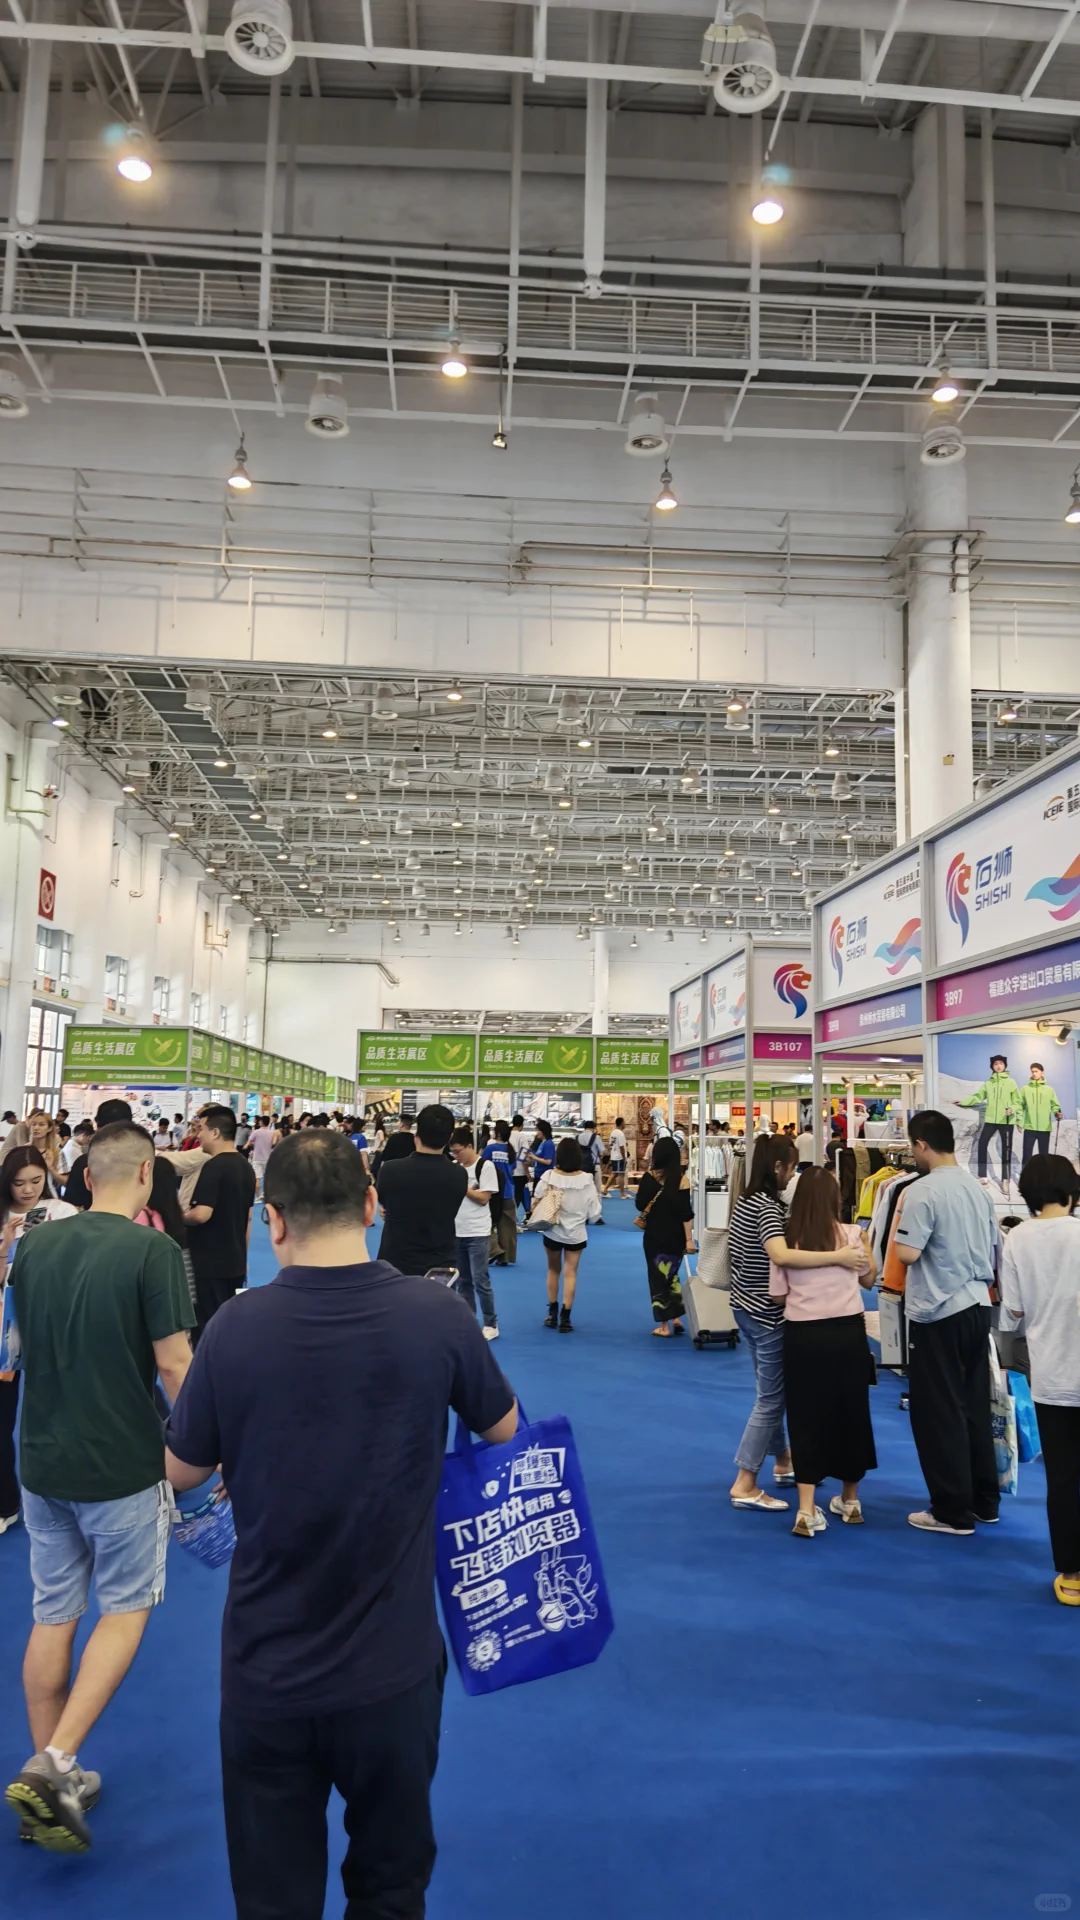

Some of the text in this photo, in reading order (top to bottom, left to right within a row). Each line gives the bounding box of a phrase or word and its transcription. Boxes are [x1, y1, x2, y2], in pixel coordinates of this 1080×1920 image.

[975, 845, 1013, 891] 石狮
[975, 881, 1013, 912] SHISHI
[846, 915, 868, 946] 石狮
[846, 942, 868, 962] SHISHI
[944, 989, 963, 1007] 3B97
[71, 1041, 137, 1056] 品质生活展区
[365, 1046, 428, 1060] 品质生活展区
[483, 1049, 545, 1063] 品质生活展区
[769, 1041, 802, 1052] 3B107
[600, 1052, 661, 1066] 品质生活展区
[443, 1493, 556, 1551] 下店快就用
[450, 1509, 581, 1586] 飞跨浏览器
